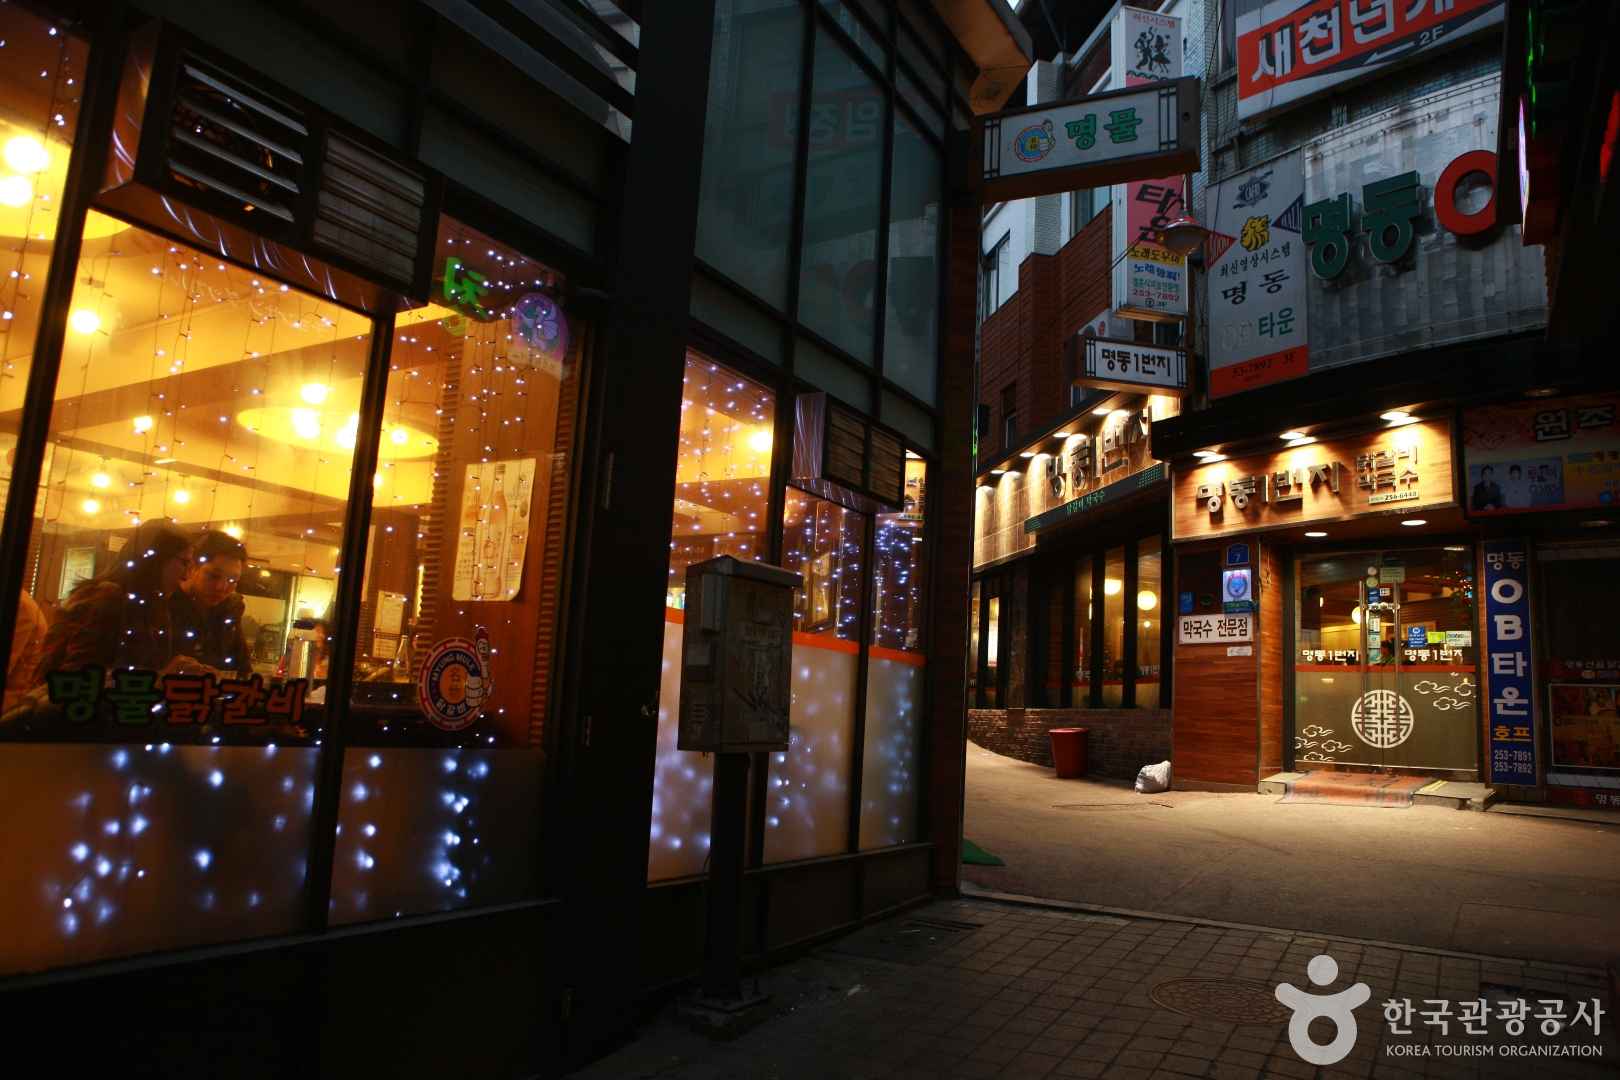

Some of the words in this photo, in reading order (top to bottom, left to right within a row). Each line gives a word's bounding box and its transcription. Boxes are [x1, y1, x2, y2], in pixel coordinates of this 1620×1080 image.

[1419, 26, 1445, 46] 2F
[1065, 107, 1143, 150] 명물
[1302, 170, 1421, 280] 명동
[1222, 269, 1291, 305] 명동
[1258, 307, 1296, 338] 타운
[1102, 349, 1170, 377] 명동1번지
[1196, 461, 1343, 513] 명동1번지
[1487, 552, 1527, 570] 명동
[1183, 620, 1213, 638] 막국수
[1217, 617, 1248, 637] 전문점
[1303, 650, 1360, 662] 명동1번지
